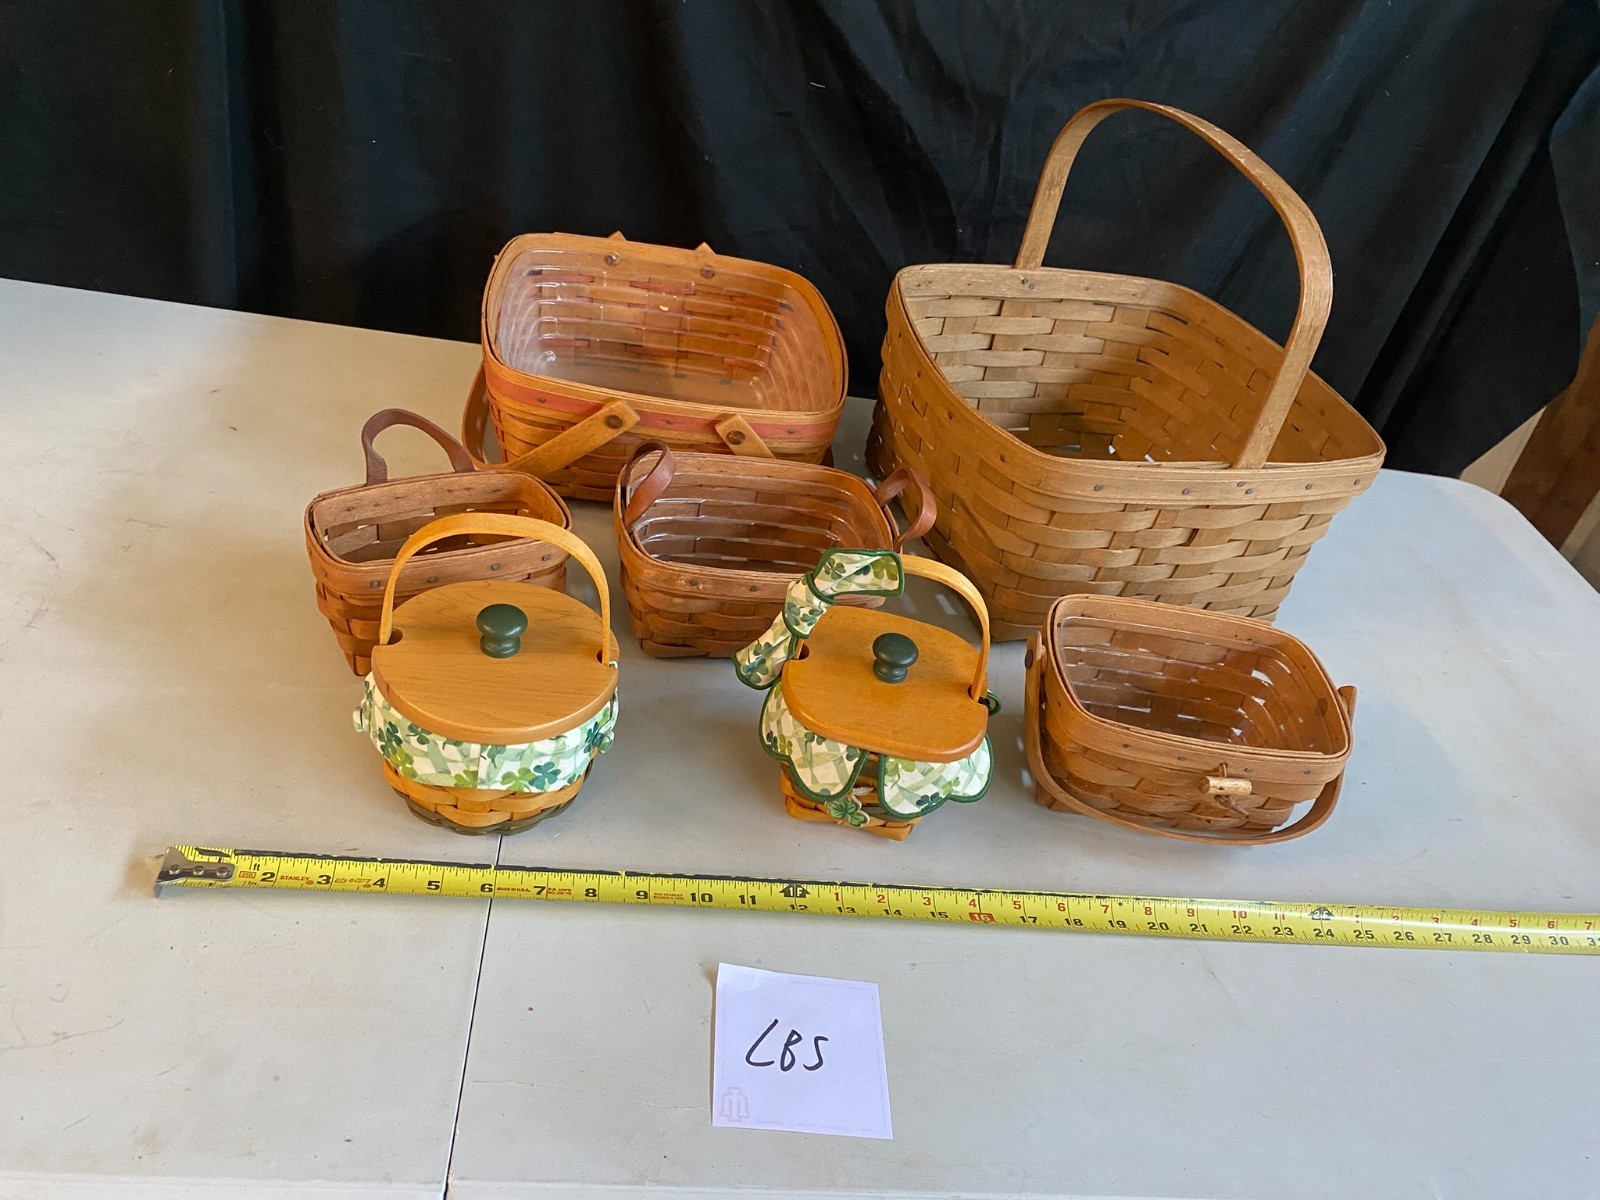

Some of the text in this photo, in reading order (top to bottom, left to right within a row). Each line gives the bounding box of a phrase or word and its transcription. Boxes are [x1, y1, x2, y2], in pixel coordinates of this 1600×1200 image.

[260, 871, 276, 883] 2
[316, 874, 332, 885] 3
[372, 877, 386, 888] 4
[427, 880, 441, 891] 5
[480, 883, 494, 893] 6
[533, 885, 546, 896] 7
[584, 888, 598, 898] 8
[636, 890, 649, 900] 9
[690, 892, 713, 903] 10
[738, 894, 757, 905] 11
[789, 904, 810, 912] 12
[837, 906, 856, 914] 13
[883, 908, 903, 917] 14
[929, 911, 949, 920] 15
[971, 913, 991, 923] 16
[1019, 915, 1038, 925] 17
[1064, 917, 1084, 928] 18
[1107, 919, 1127, 930] 19
[1148, 921, 1170, 932] 20
[1189, 923, 1209, 934] 21
[1231, 924, 1255, 936] 22
[1272, 926, 1295, 937] 23
[1313, 928, 1335, 938] 24
[1353, 930, 1375, 940] 25
[1393, 931, 1415, 941] 26
[1432, 932, 1453, 943] 27
[1472, 933, 1493, 944] 28
[1510, 934, 1531, 945] 29
[1548, 935, 1570, 946] 30
[789, 887, 803, 897] 1F
[834, 892, 840, 902] 1
[877, 894, 886, 904] 2
[923, 896, 932, 906] 3
[968, 898, 977, 908] 4
[1013, 900, 1022, 910] 5
[1057, 902, 1066, 912] 6
[1101, 904, 1110, 914] 7
[1144, 906, 1153, 916] 8
[1187, 908, 1195, 918] 9
[1232, 910, 1248, 920] 10
[1274, 912, 1286, 921] 11
[1471, 918, 1479, 927] 4
[1509, 919, 1518, 928] 5
[1547, 920, 1556, 929] 6
[1584, 921, 1593, 931] 7
